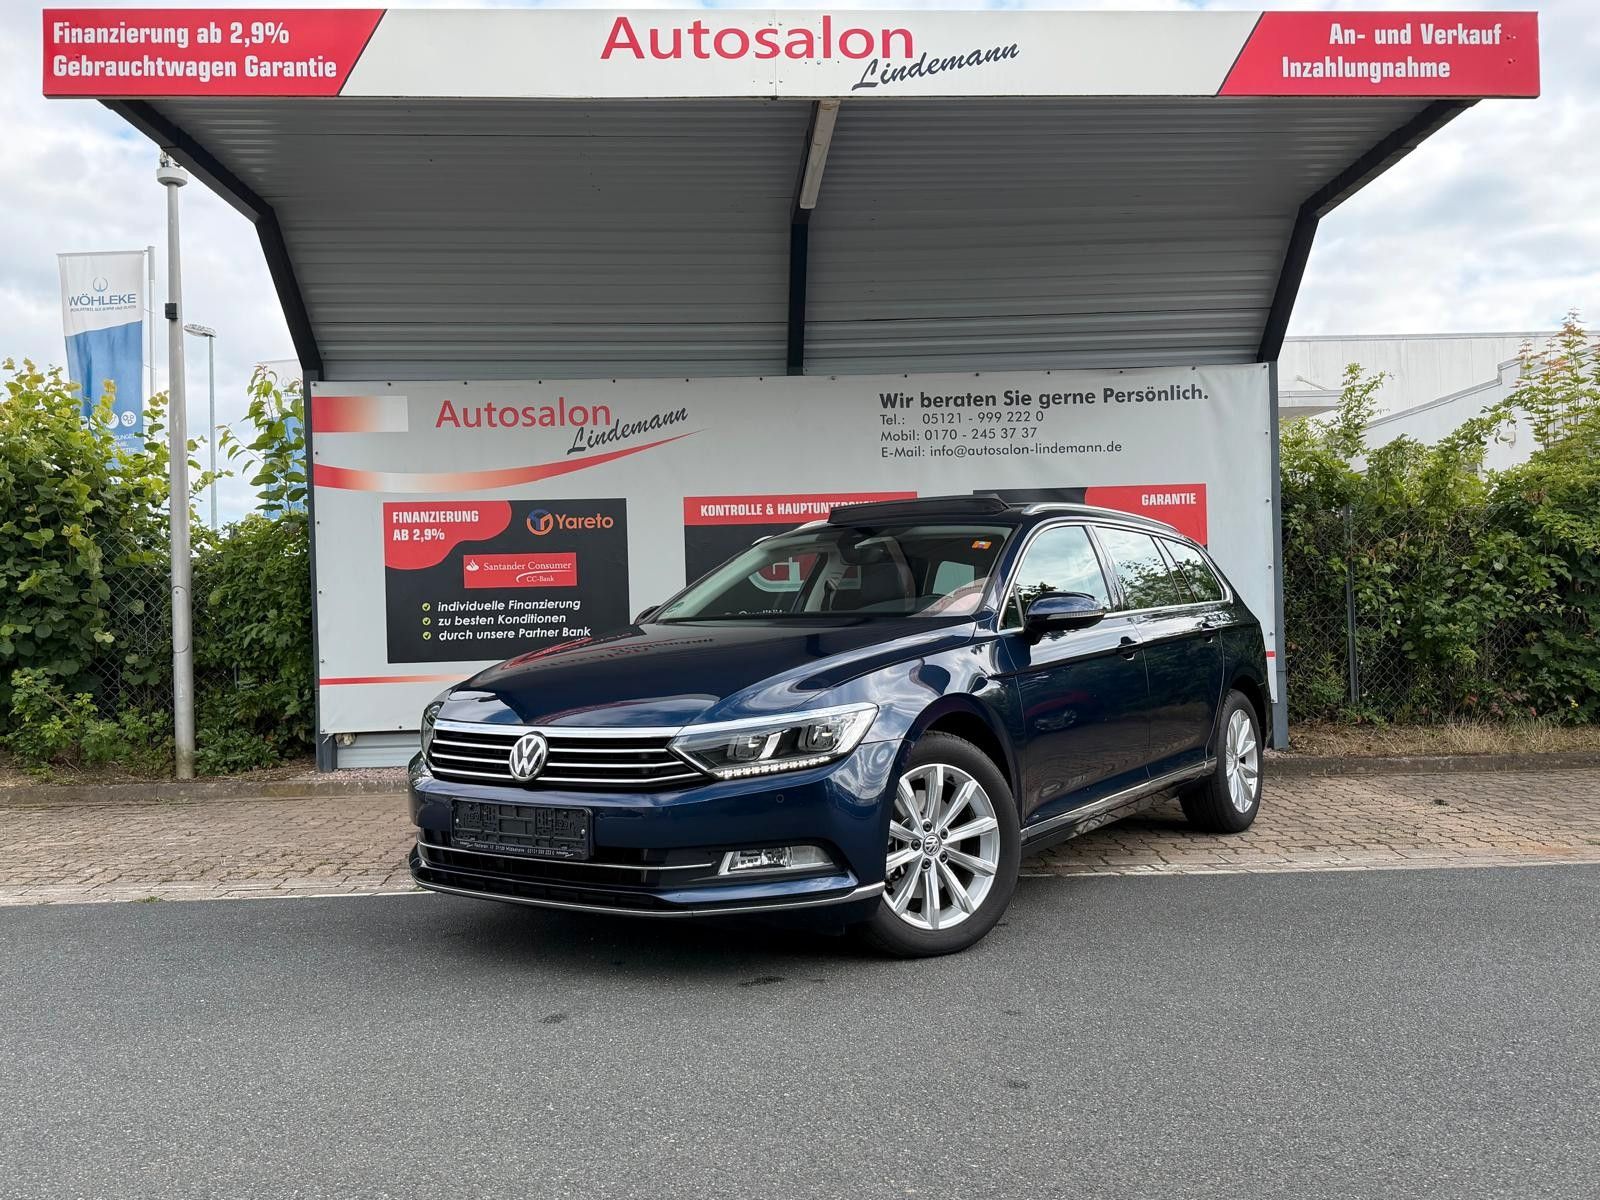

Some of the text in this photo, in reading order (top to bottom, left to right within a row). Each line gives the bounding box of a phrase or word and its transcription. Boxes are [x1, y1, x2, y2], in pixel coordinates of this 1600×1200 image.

[53, 22, 290, 48] Finanzierung ab 2,9%
[600, 15, 914, 60] Autosalon
[1329, 23, 1502, 45] An- und Verkauf
[53, 55, 337, 83] Gebrauchtwagen Garantie
[851, 42, 1020, 91] Lindemann
[1282, 56, 1450, 83] Inzahlungnahme
[68, 293, 136, 306] WÖHLEKE
[879, 384, 1209, 409] Wir beraten Sie gerne Persönlich.
[435, 397, 611, 428] Autosalon
[880, 414, 905, 425] Tel.:
[922, 412, 962, 425] 05121
[977, 412, 1002, 424] 999
[1007, 411, 1031, 423] 222
[1035, 411, 1044, 423] 0
[567, 407, 689, 455] Lindemann
[880, 430, 920, 442] Mobil:
[924, 429, 958, 441] 0170
[971, 428, 996, 440] 245
[1000, 427, 1017, 439] 37
[1021, 427, 1037, 439] 37
[881, 441, 1122, 458] E-Mail: info@autosalon-lindemann.de
[1141, 492, 1197, 506] GARANTIE
[392, 510, 479, 524] FINANZIERUNG
[700, 503, 763, 517] KONTROLLE
[766, 503, 774, 515] &
[555, 513, 614, 530] Yareto
[393, 528, 445, 543] AB 2,9%
[483, 561, 572, 571] Santander Consumer
[437, 599, 581, 612] individuelle Finanzierung
[438, 613, 566, 626] zu besten Konditionen
[438, 626, 591, 641] durch unsere Partner Bank
